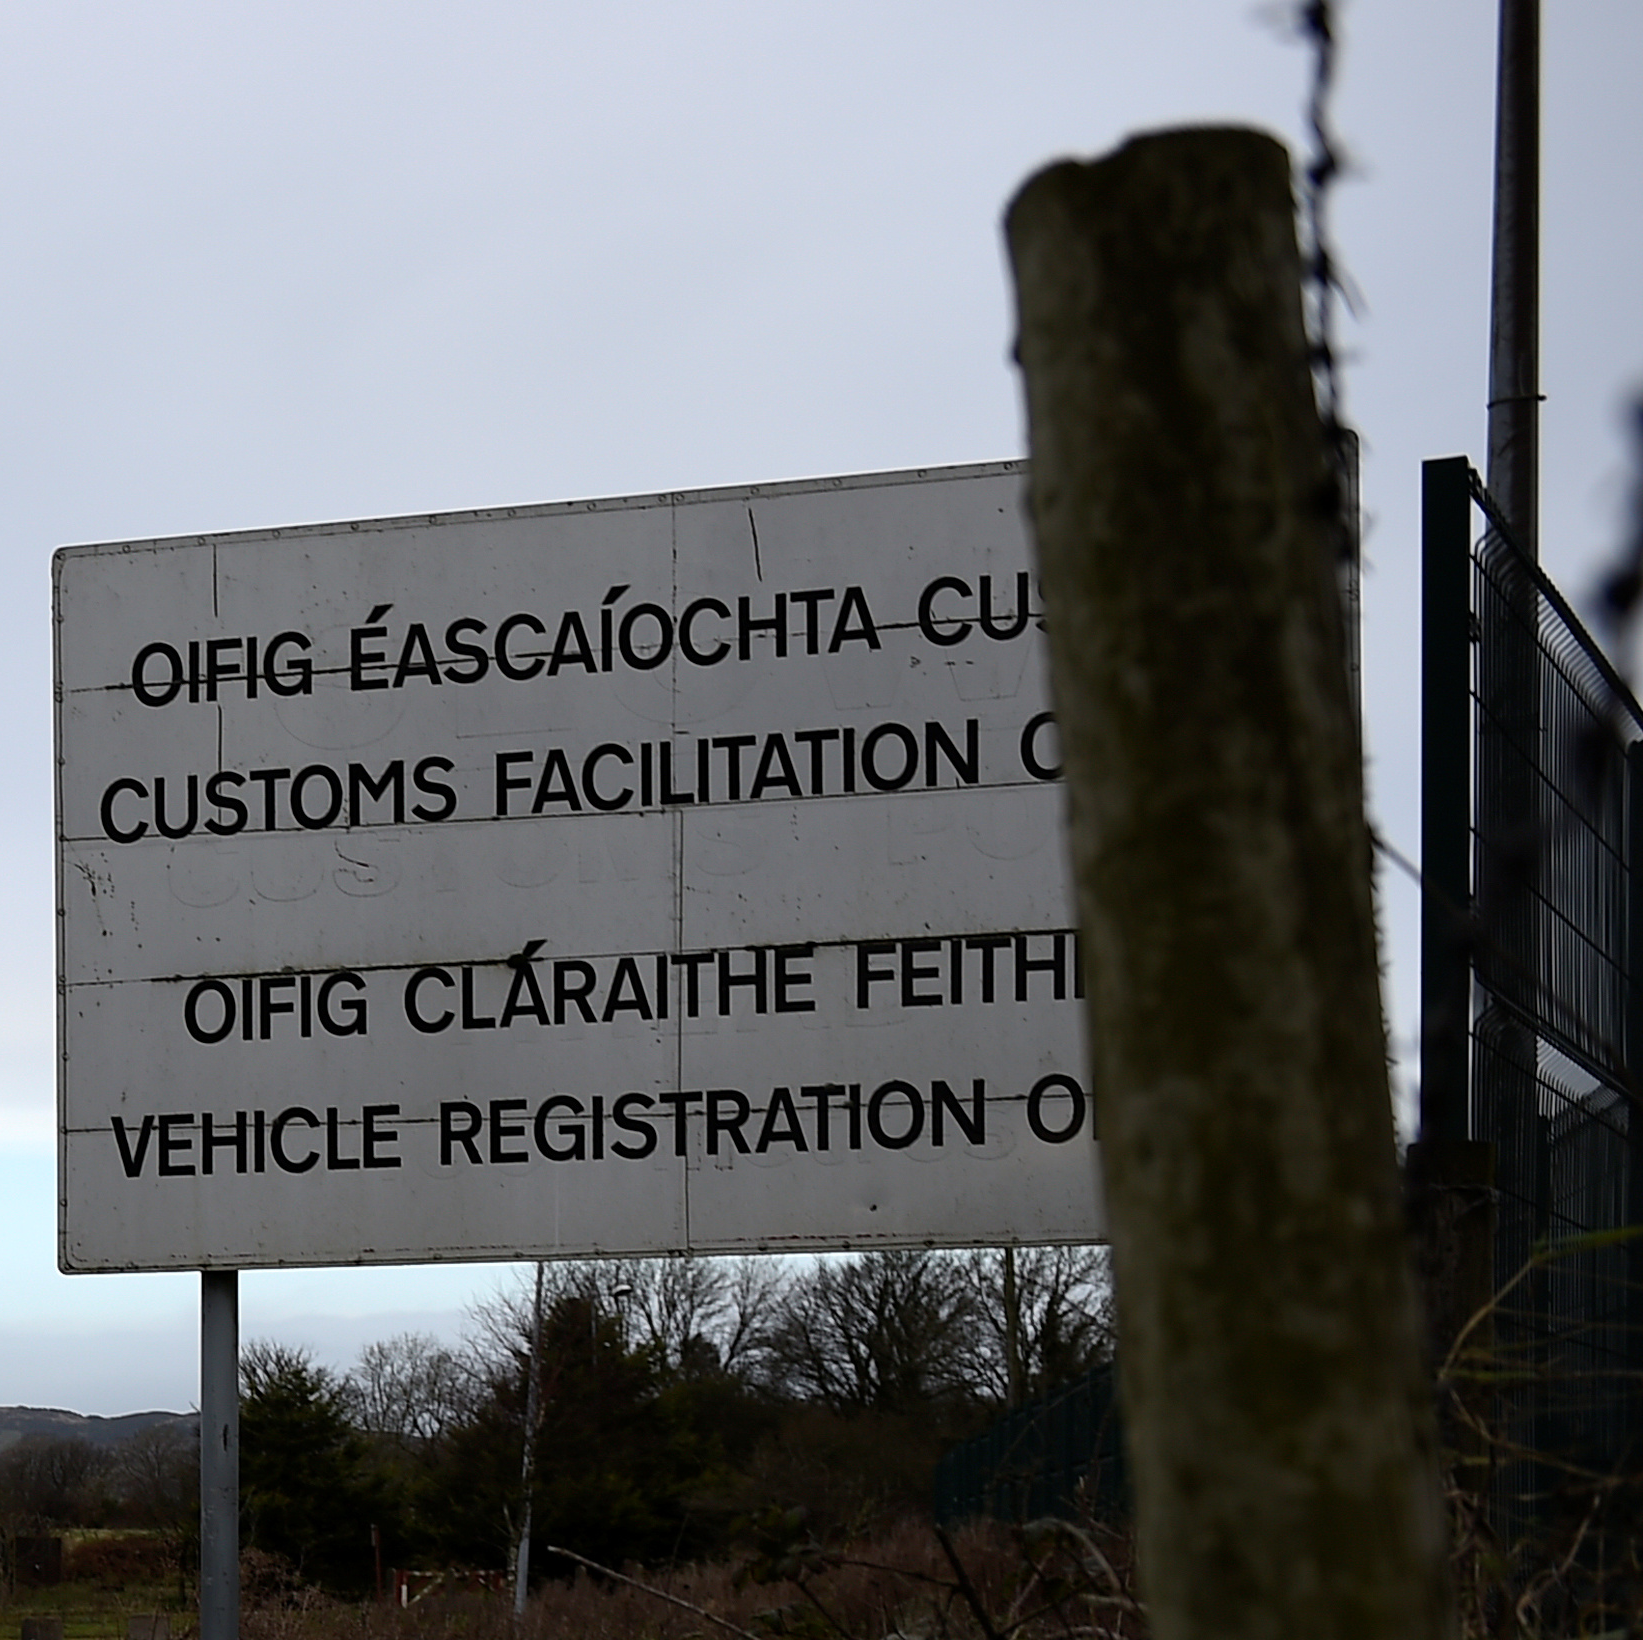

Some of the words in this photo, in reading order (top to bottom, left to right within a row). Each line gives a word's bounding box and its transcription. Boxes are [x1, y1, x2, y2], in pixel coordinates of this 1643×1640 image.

[130, 632, 314, 708] OIFIG
[348, 585, 882, 692] ÉASCAÍOCHTA
[918, 570, 1049, 648] CU
[99, 755, 458, 844] CUSTOMS
[494, 717, 980, 817] FACILITATION
[183, 968, 368, 1045] OIFIG
[403, 939, 817, 1034] CLÁRAITHE
[112, 1104, 402, 1179] VEHICLE
[439, 1078, 986, 1166] REGISTRATION
[1026, 1073, 1099, 1144] O
